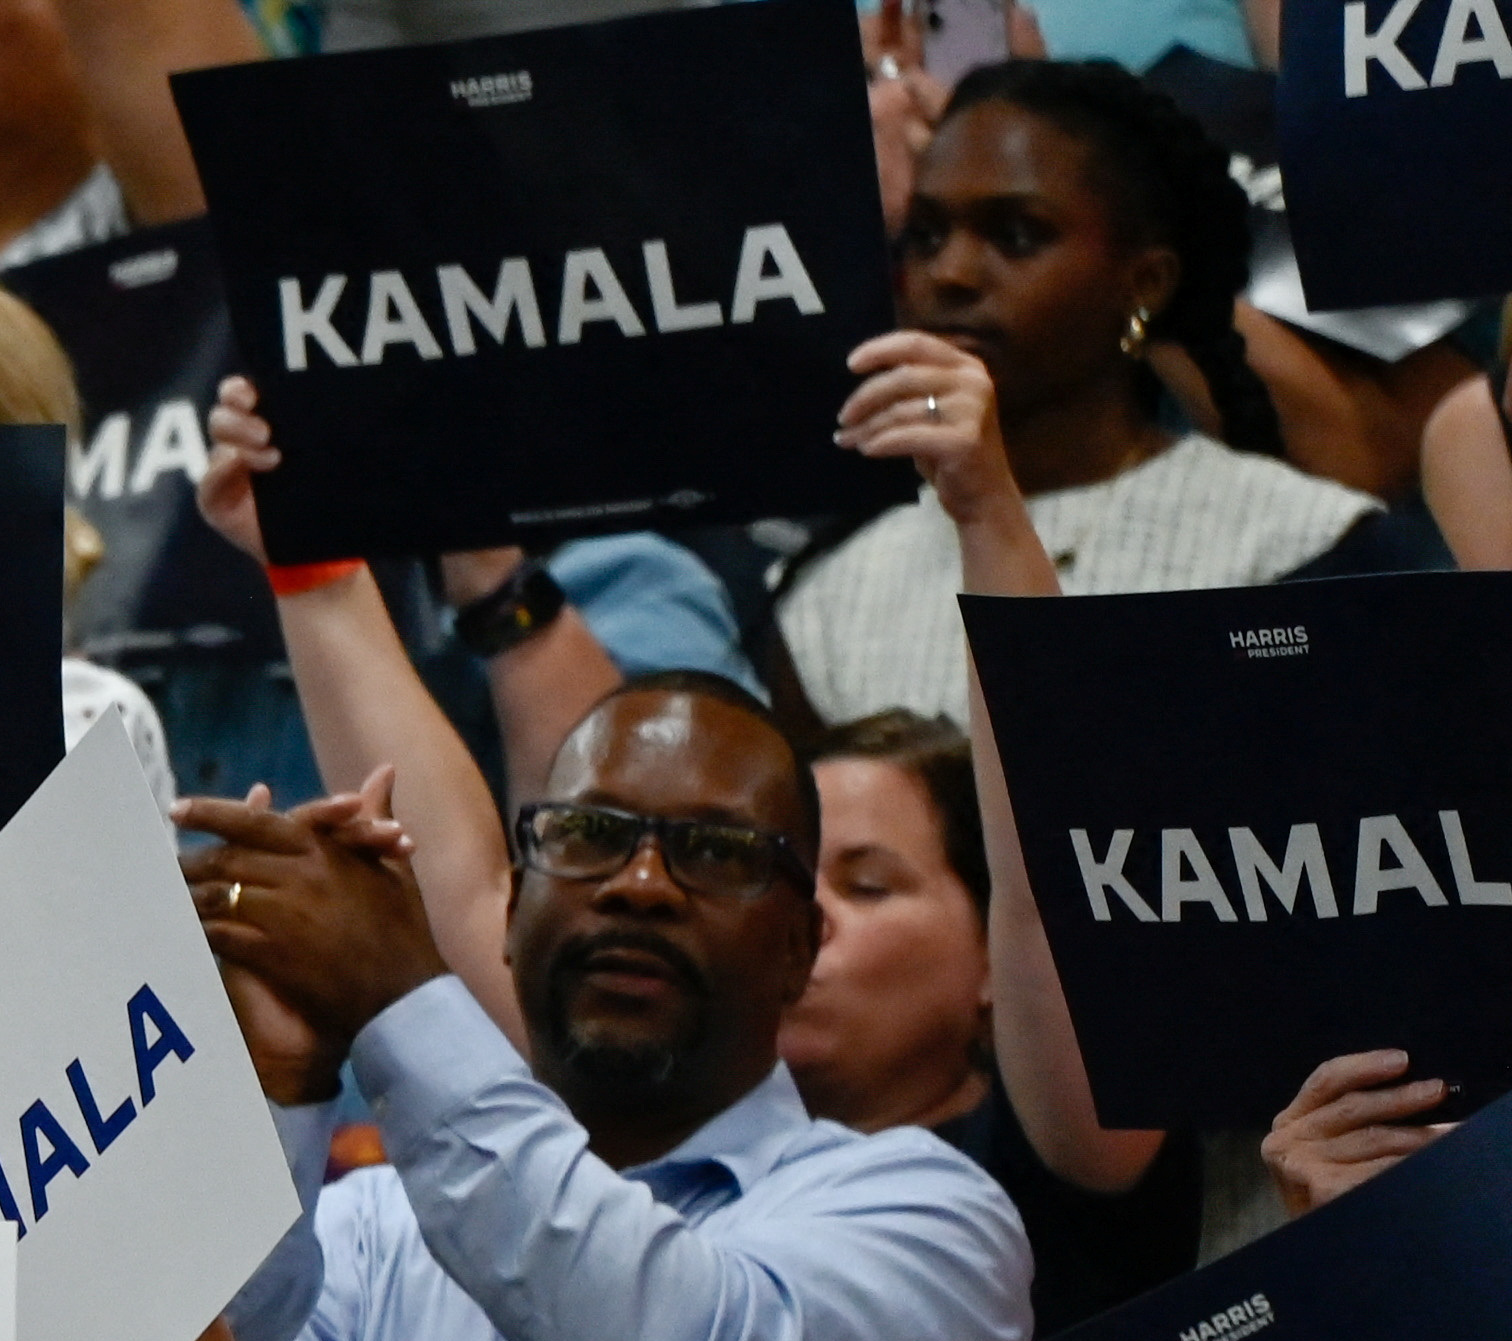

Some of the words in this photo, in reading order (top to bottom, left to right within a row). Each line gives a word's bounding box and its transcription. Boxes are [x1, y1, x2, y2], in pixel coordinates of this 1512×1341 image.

[278, 223, 825, 371] KAMALA
[1228, 625, 1309, 650] HARRIS
[1247, 644, 1310, 659] PRESIDENT
[1069, 810, 1512, 924] KAMAL
